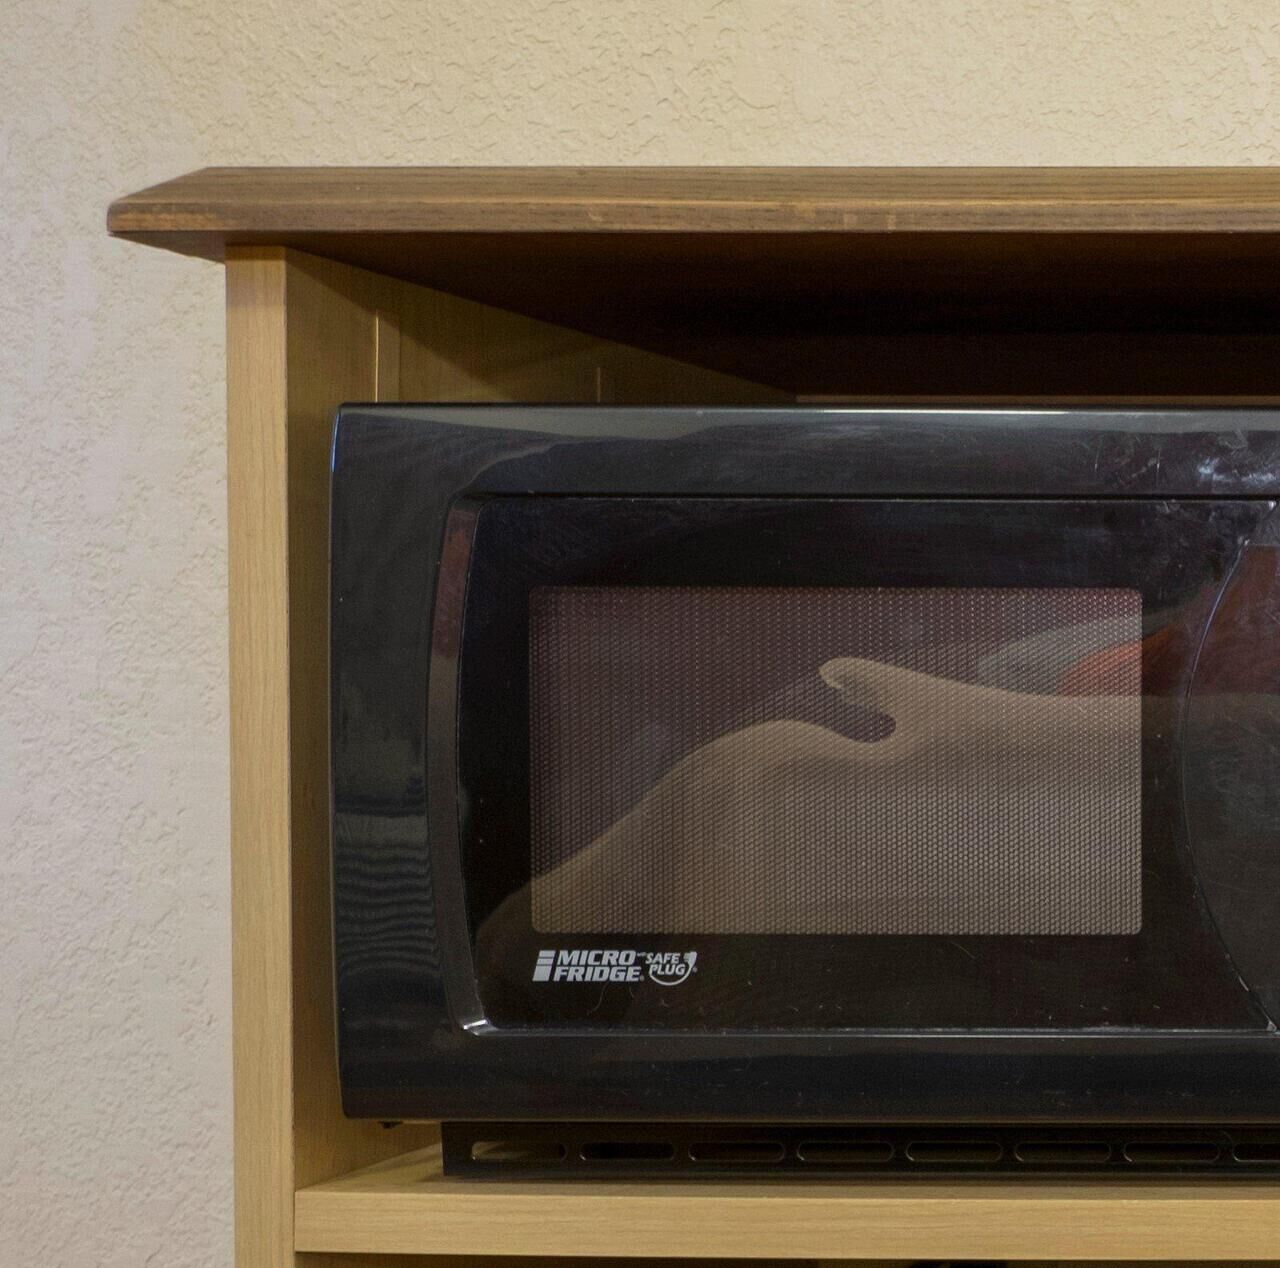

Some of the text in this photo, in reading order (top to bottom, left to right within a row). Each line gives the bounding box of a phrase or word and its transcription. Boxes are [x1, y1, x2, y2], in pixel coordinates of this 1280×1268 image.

[555, 950, 636, 966] MICRO
[645, 952, 681, 964] SAFE
[553, 966, 642, 982] FRIDGE
[649, 964, 686, 975] PLUG
